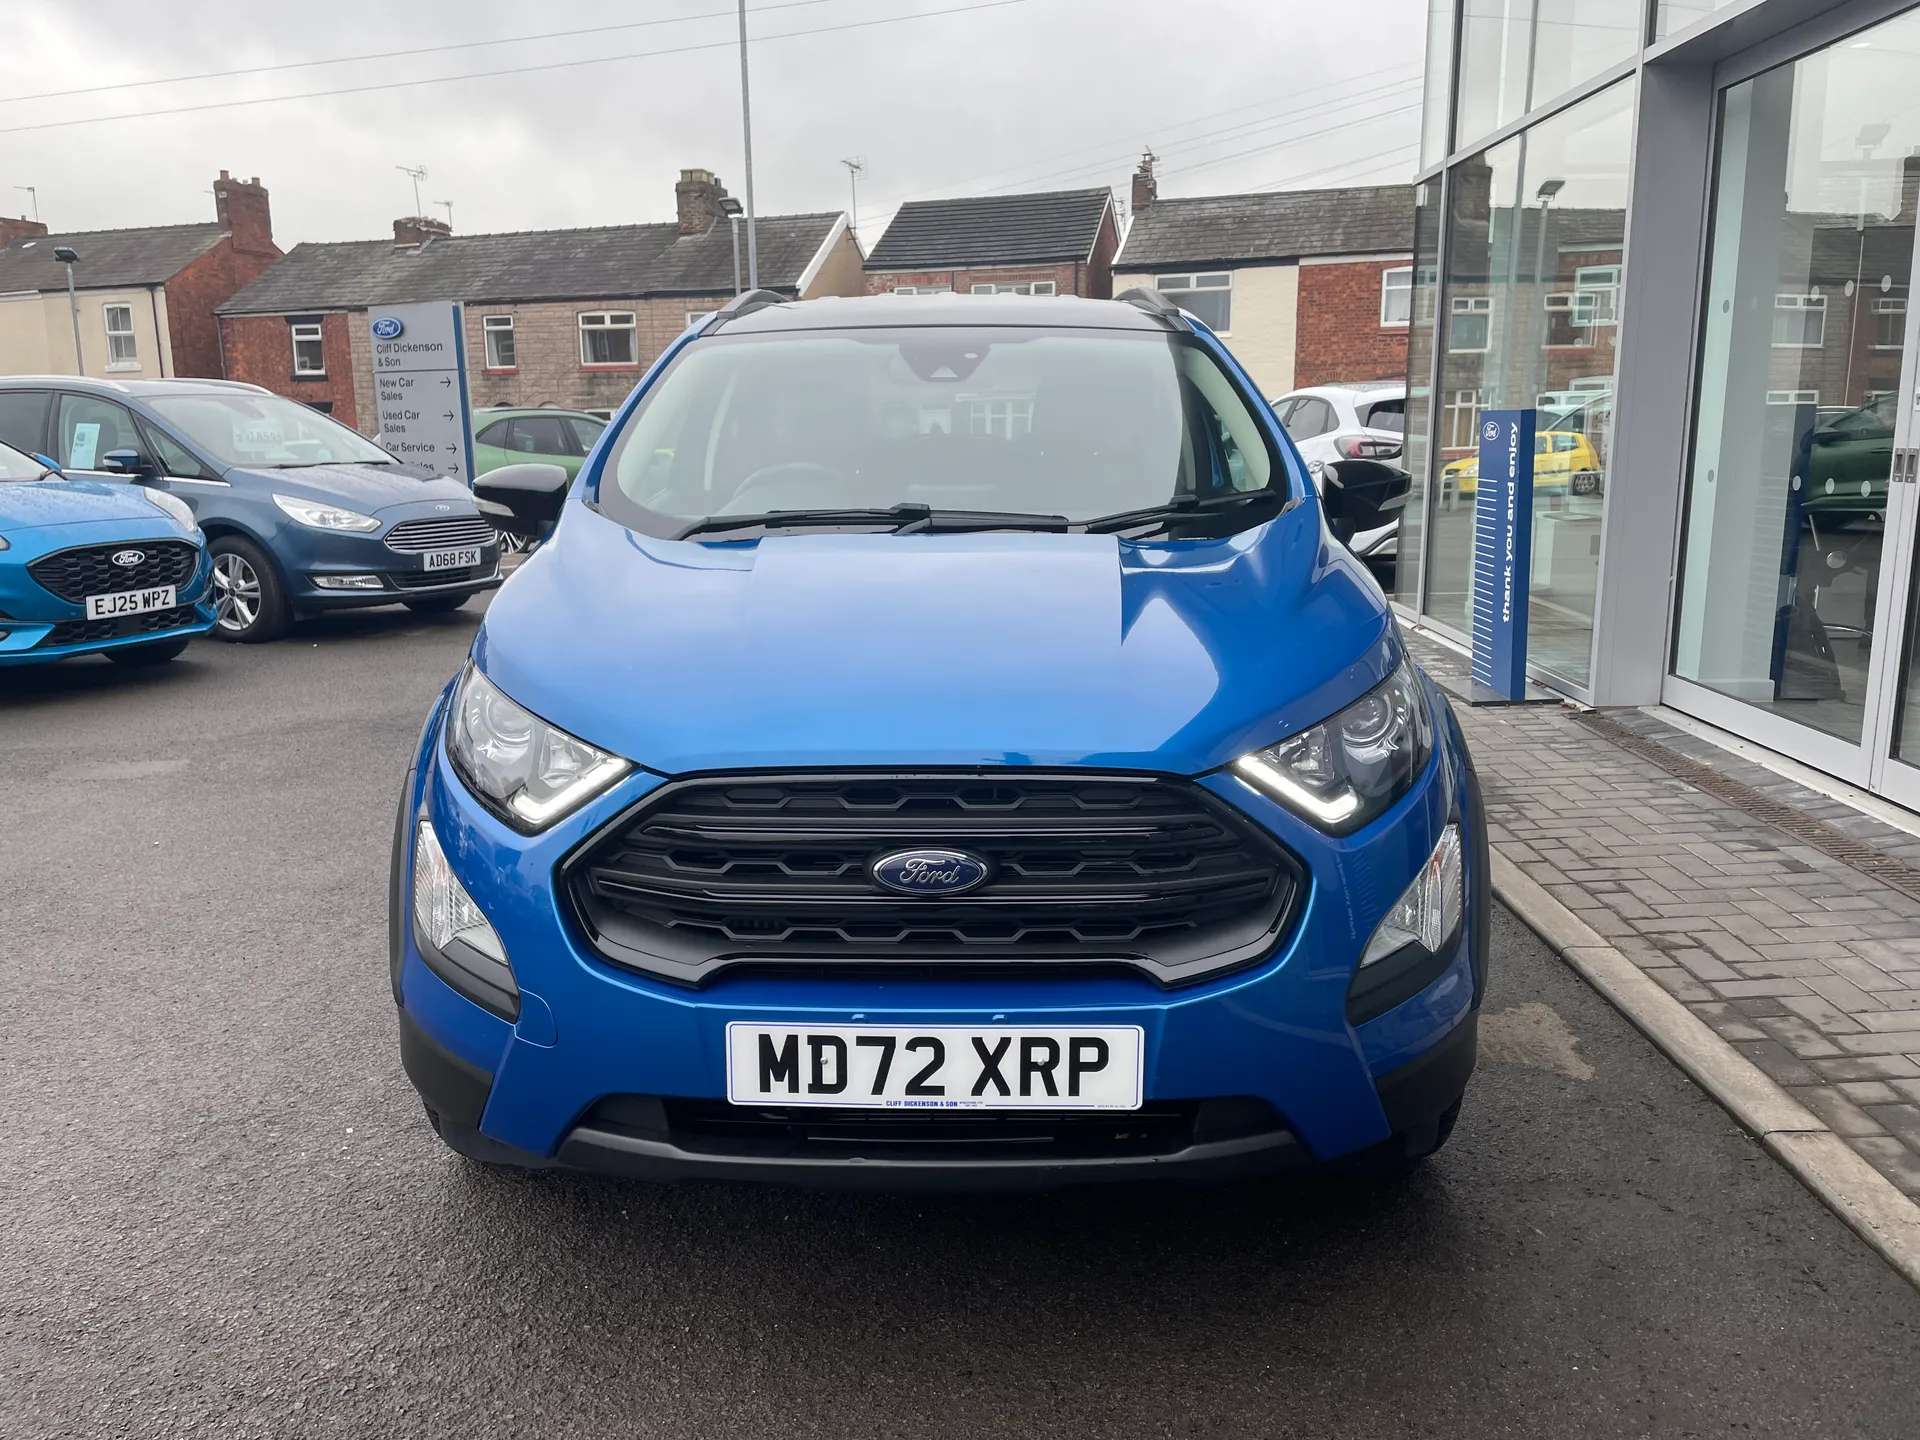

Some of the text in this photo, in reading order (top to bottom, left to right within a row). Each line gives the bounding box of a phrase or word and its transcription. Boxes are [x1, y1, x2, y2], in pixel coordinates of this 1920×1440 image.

[377, 320, 395, 335] Ford
[376, 343, 443, 354] Cliff Dickenson
[378, 357, 401, 367] & Son
[379, 377, 414, 388] New Car
[381, 390, 403, 401] Sales
[382, 410, 420, 421] Used Car
[383, 423, 406, 433] Sales
[385, 442, 435, 453] Car Service
[1508, 422, 1518, 478] enjoy
[1507, 481, 1515, 521] and
[119, 553, 139, 564] Ford
[429, 550, 477, 568] AD68 FSK
[1503, 564, 1512, 623] thank
[95, 590, 169, 615] EJ25 WPZ
[900, 858, 961, 883] Ford
[758, 1033, 1110, 1098] MD72 XRP
